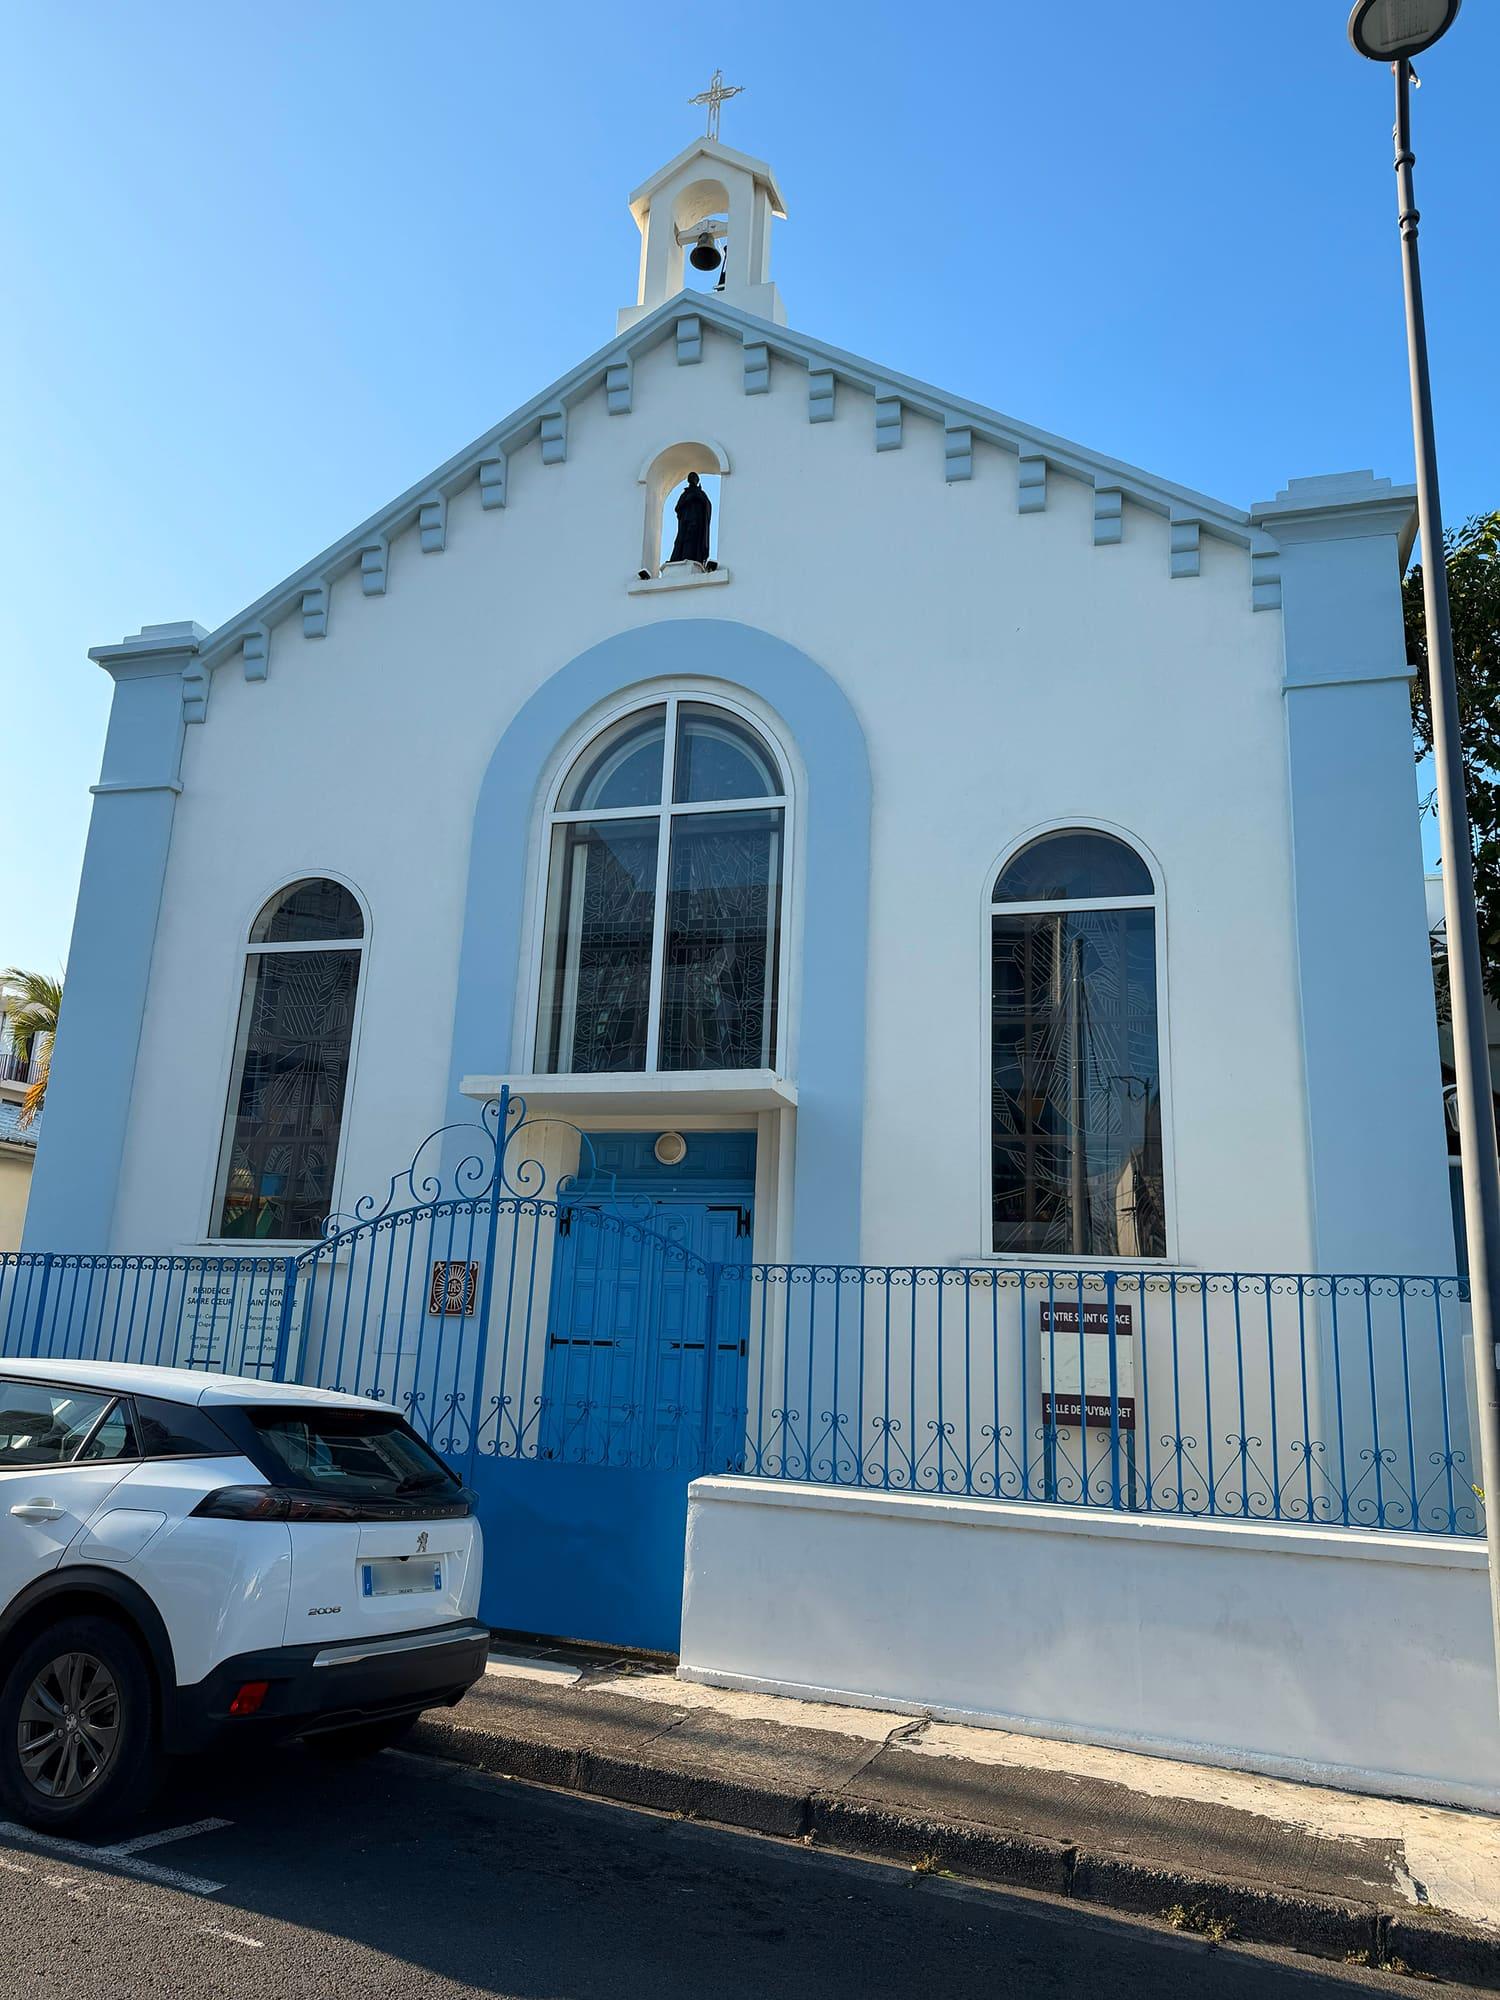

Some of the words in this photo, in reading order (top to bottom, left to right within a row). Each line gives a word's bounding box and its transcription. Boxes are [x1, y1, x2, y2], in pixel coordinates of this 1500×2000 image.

[192, 1286, 231, 1295] RSIDENCE
[259, 1288, 287, 1296] CENTR
[448, 1281, 461, 1293] IHS
[269, 1299, 298, 1308] IGNE
[1074, 1312, 1098, 1323] SINT
[1099, 1313, 1131, 1325] IGACE
[1046, 1403, 1069, 1415] SLLE
[1070, 1404, 1081, 1415] DE
